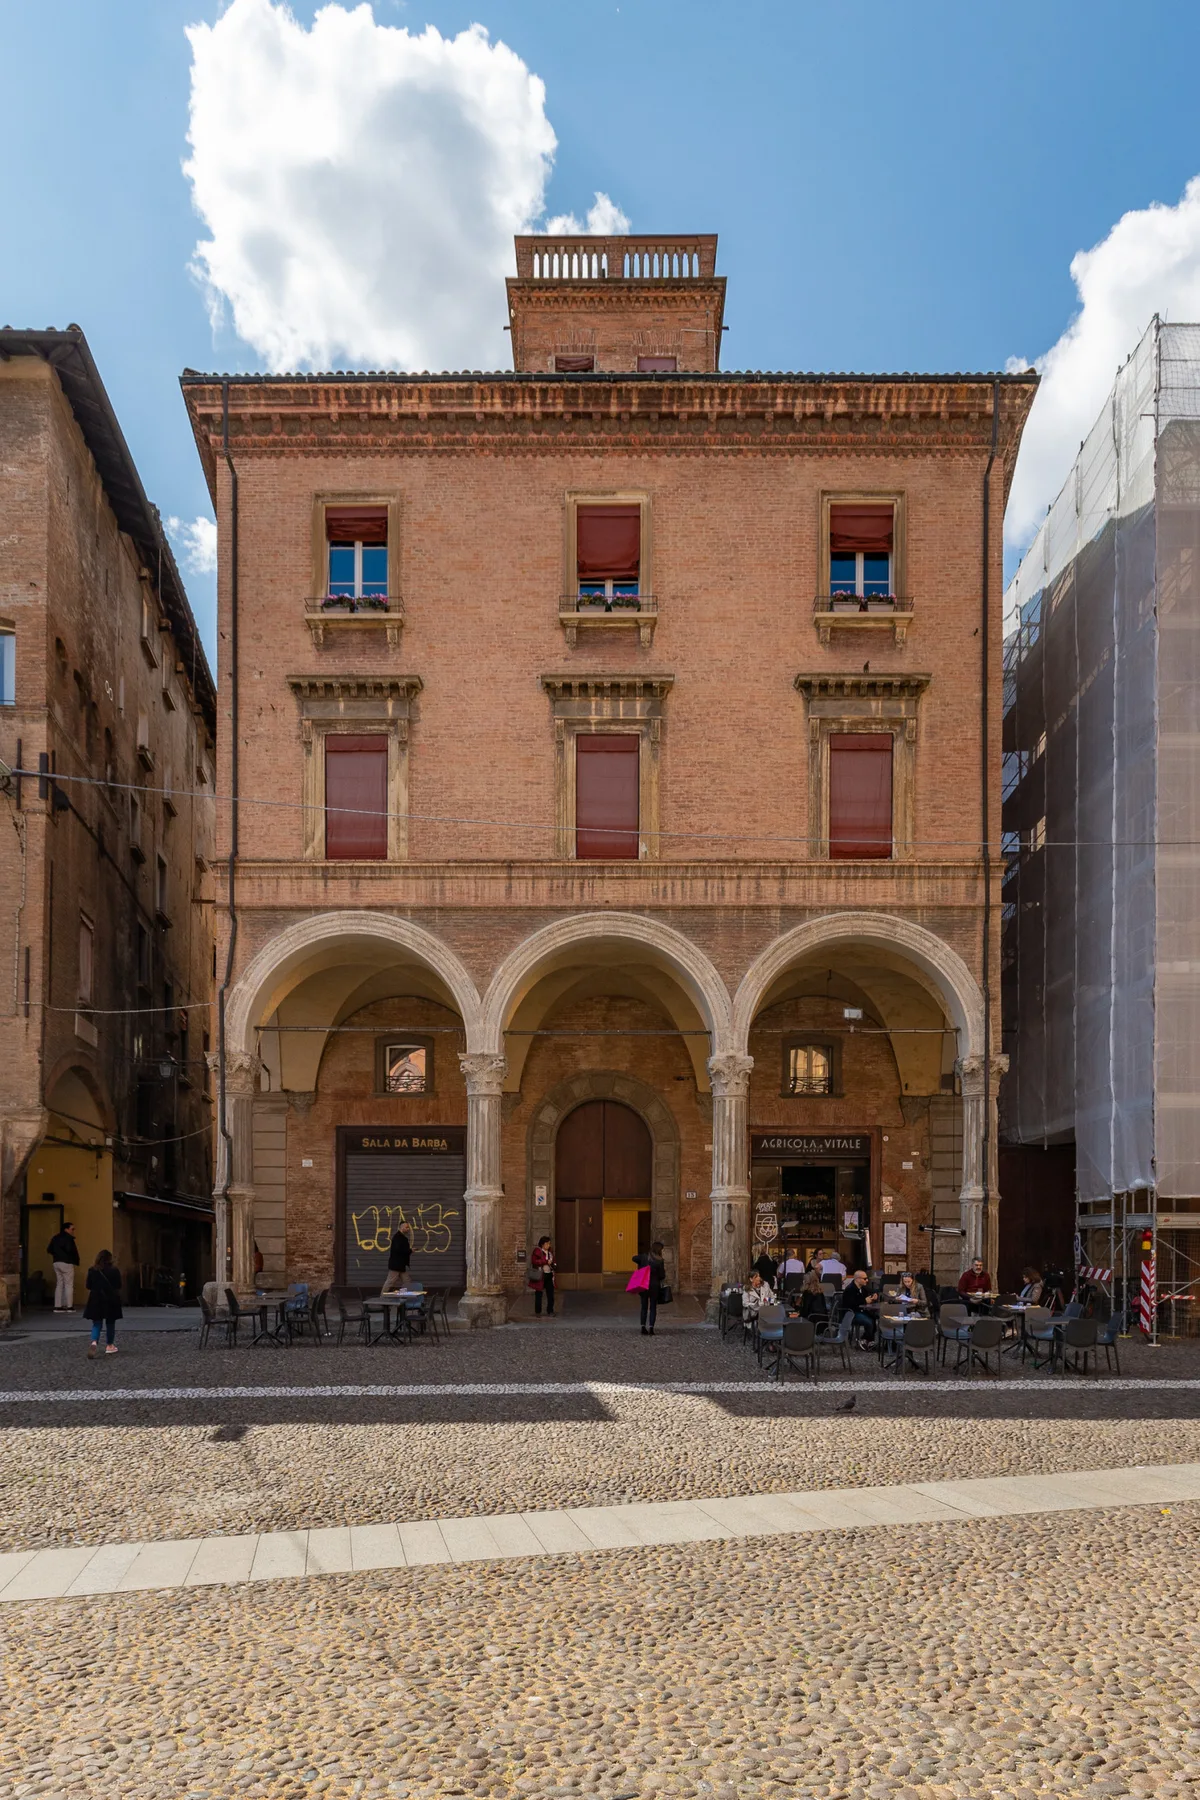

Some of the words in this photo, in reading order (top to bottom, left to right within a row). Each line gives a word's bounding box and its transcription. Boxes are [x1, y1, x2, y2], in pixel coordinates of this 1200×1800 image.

[362, 1138, 390, 1147] SALA
[394, 1139, 408, 1147] DA
[412, 1138, 448, 1148] BARBA
[761, 1138, 817, 1149] AGRICOLA
[825, 1139, 861, 1149] VITALE
